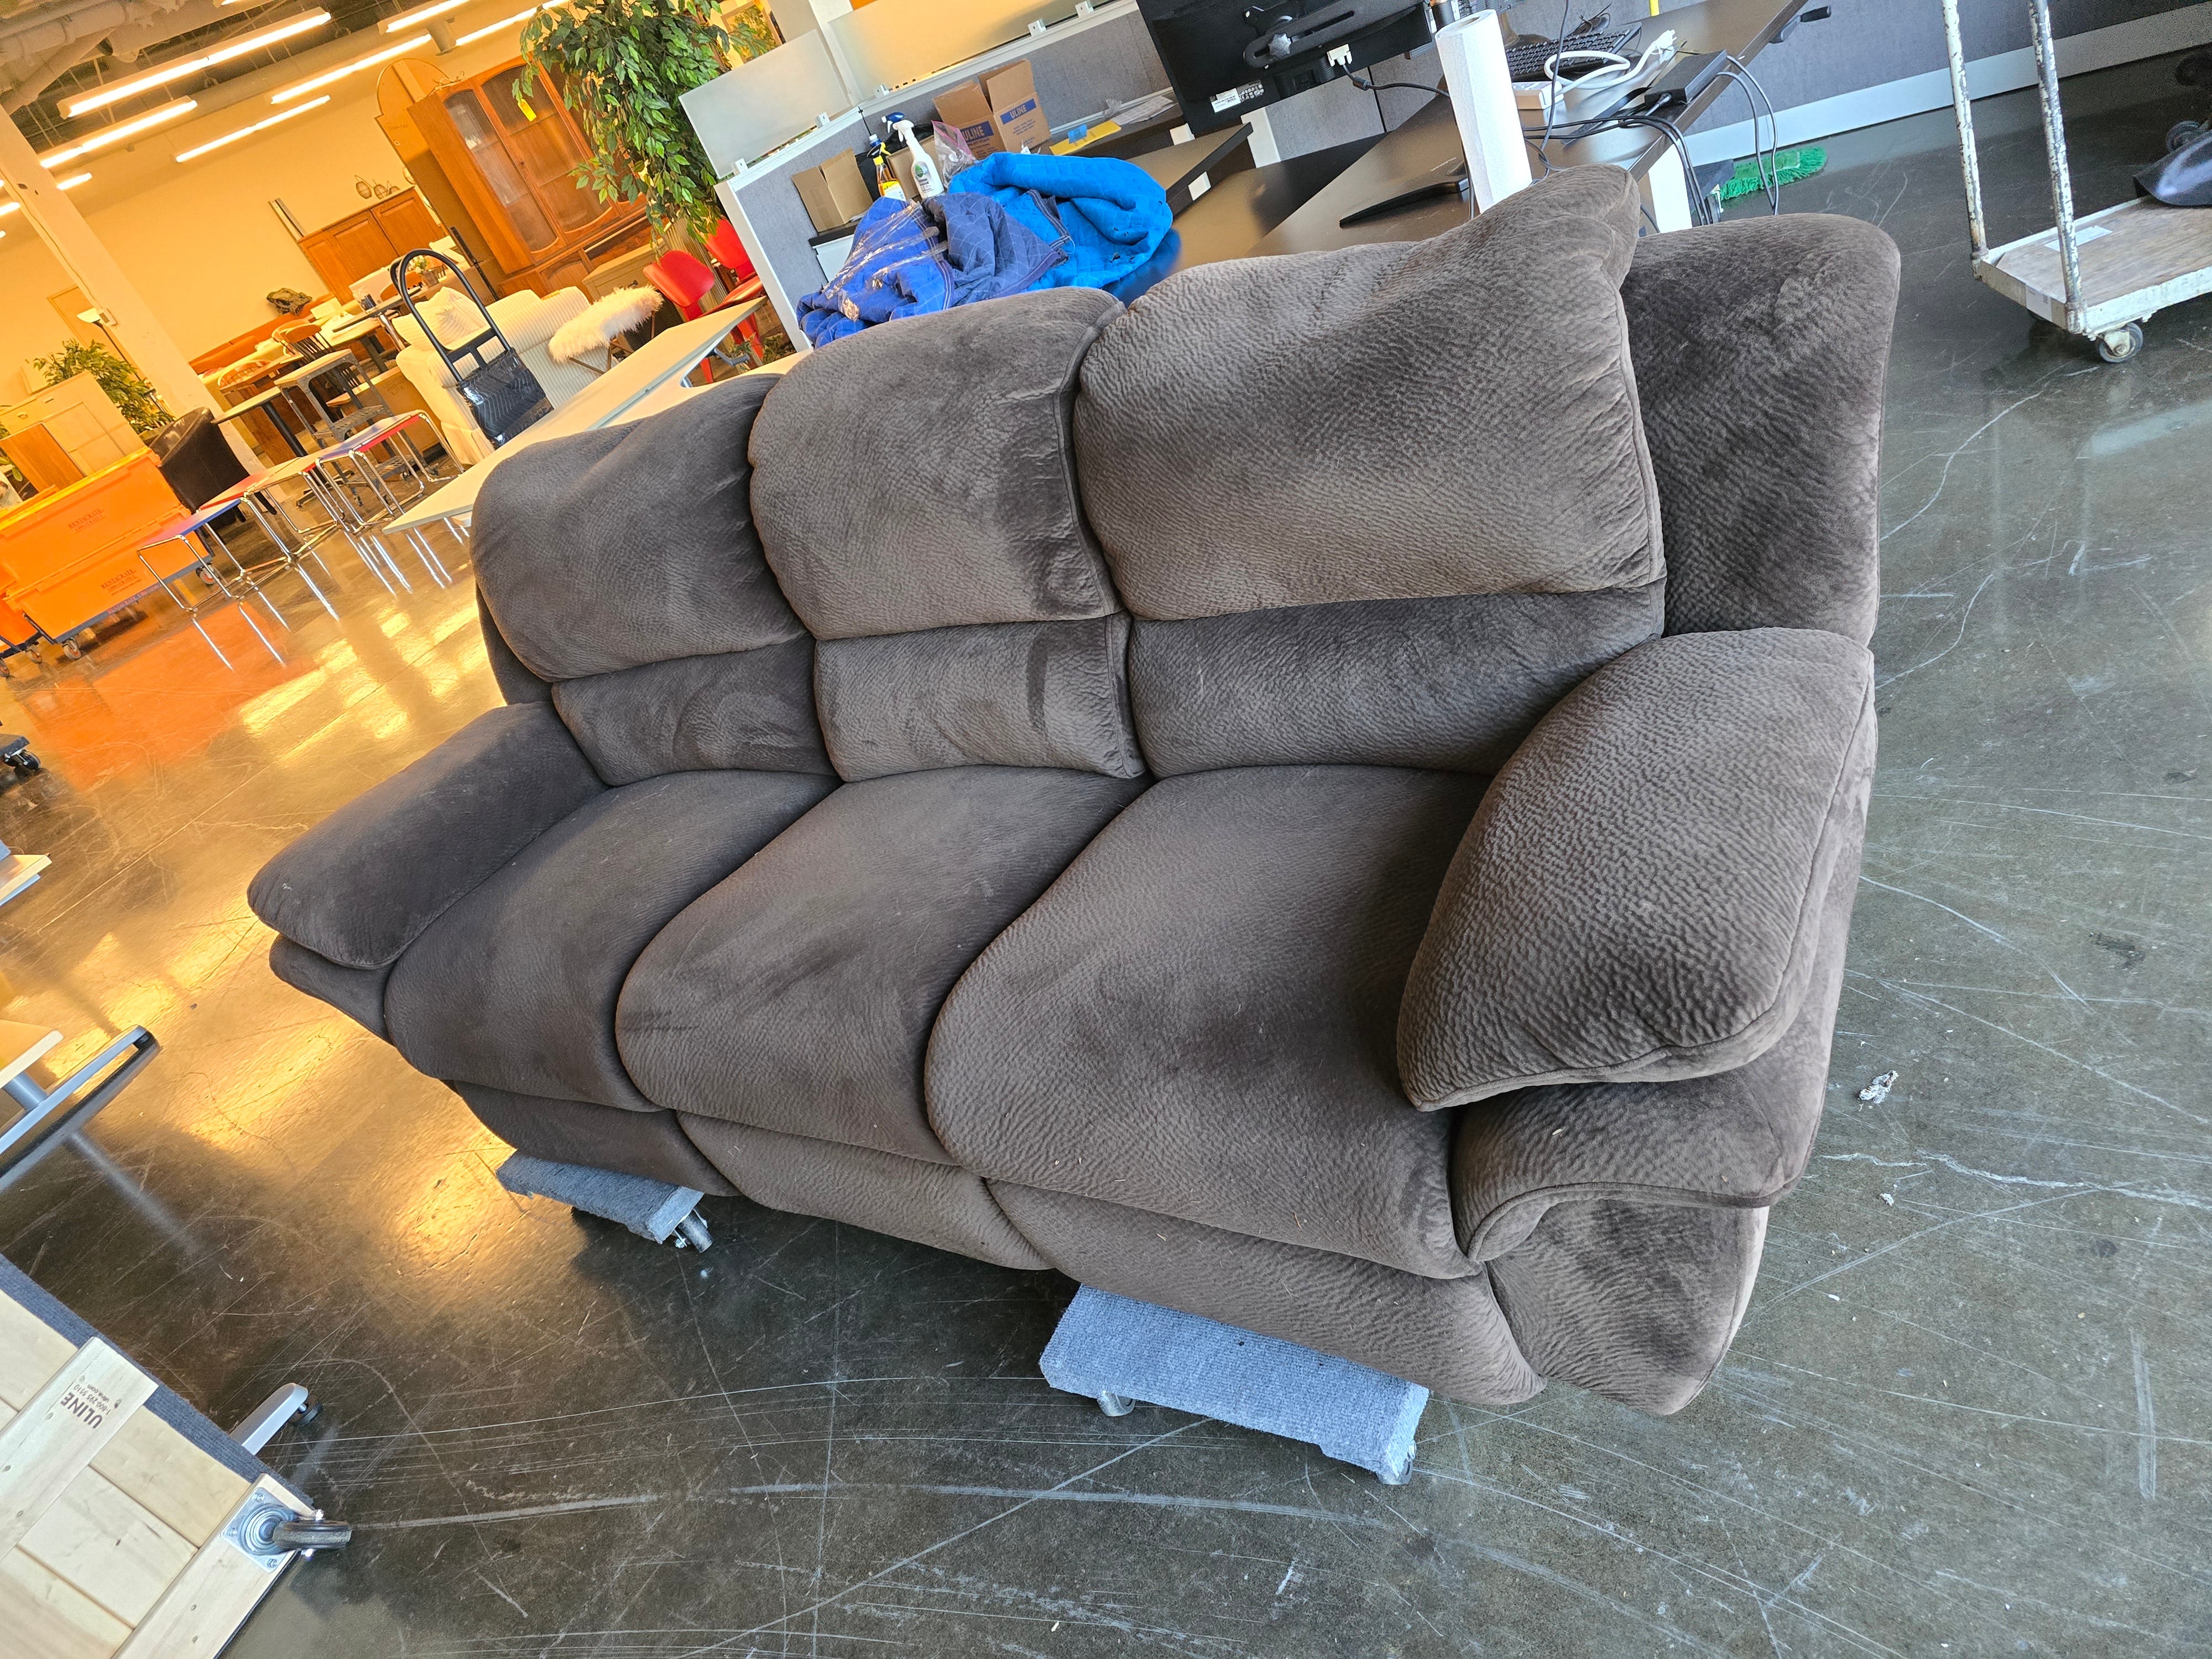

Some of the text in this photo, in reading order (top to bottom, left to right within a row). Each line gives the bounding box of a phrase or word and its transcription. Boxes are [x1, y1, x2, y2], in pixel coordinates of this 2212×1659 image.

[1010, 105, 1027, 118] ULINE
[962, 126, 985, 141] ULINE
[101, 568, 134, 590] RENTACRATE
[60, 1392, 102, 1429] ULINE
